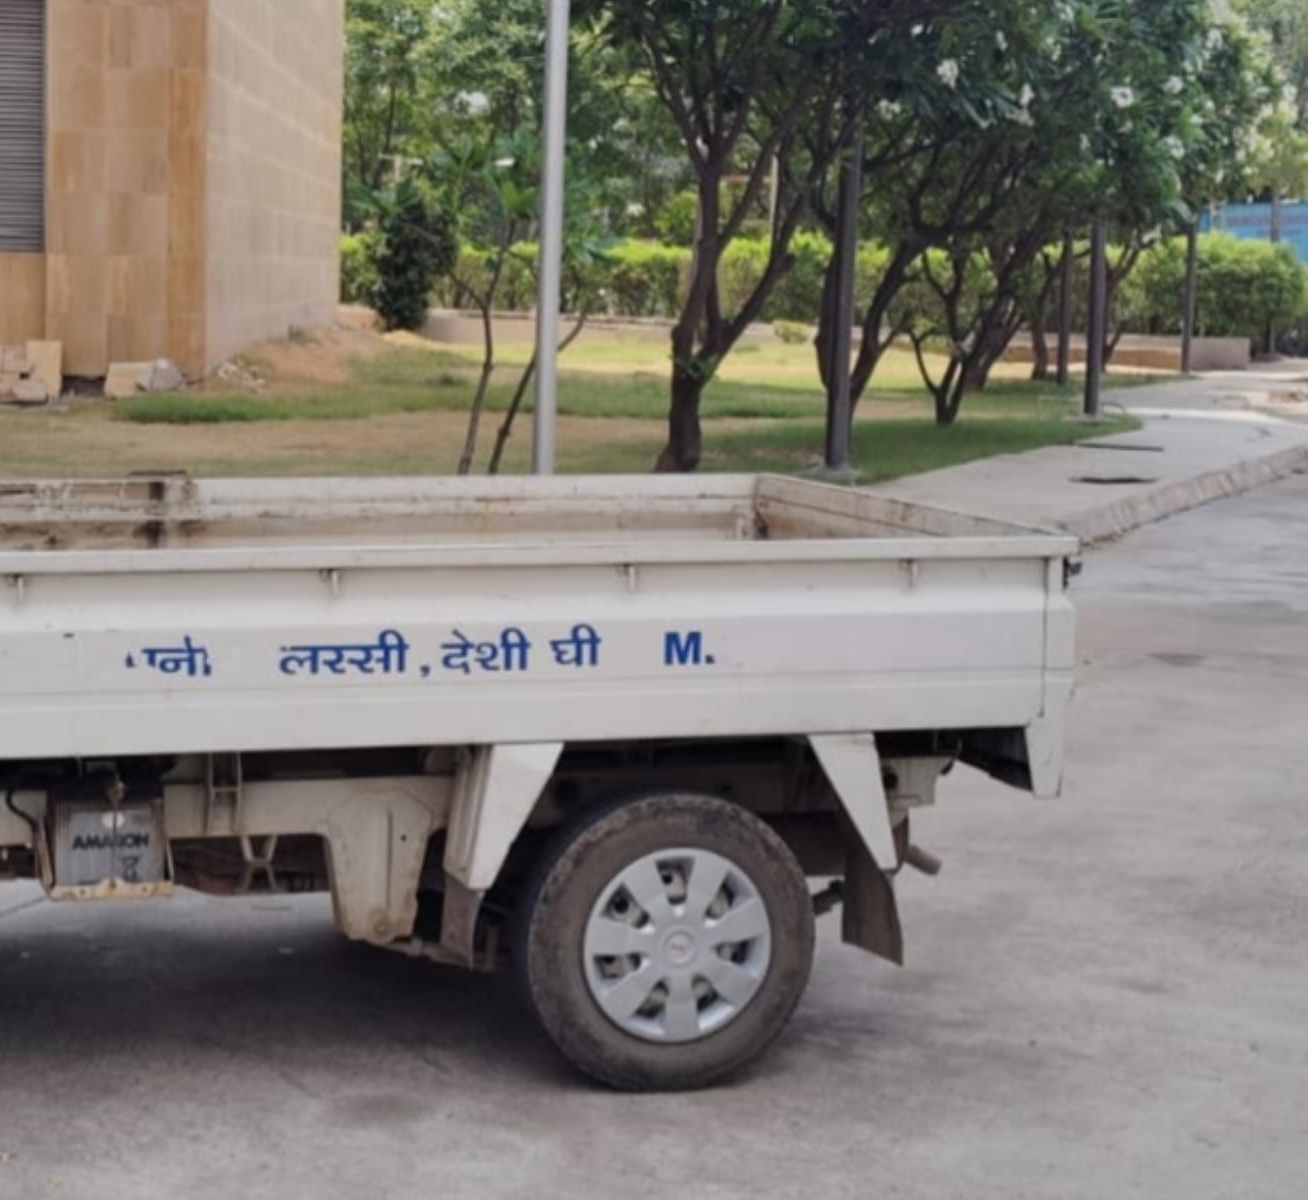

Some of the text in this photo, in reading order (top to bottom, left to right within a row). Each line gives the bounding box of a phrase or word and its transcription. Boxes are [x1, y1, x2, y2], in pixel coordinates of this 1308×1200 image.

[440, 627, 531, 675] देशी
[549, 623, 601, 667] घी
[663, 631, 715, 665] M.
